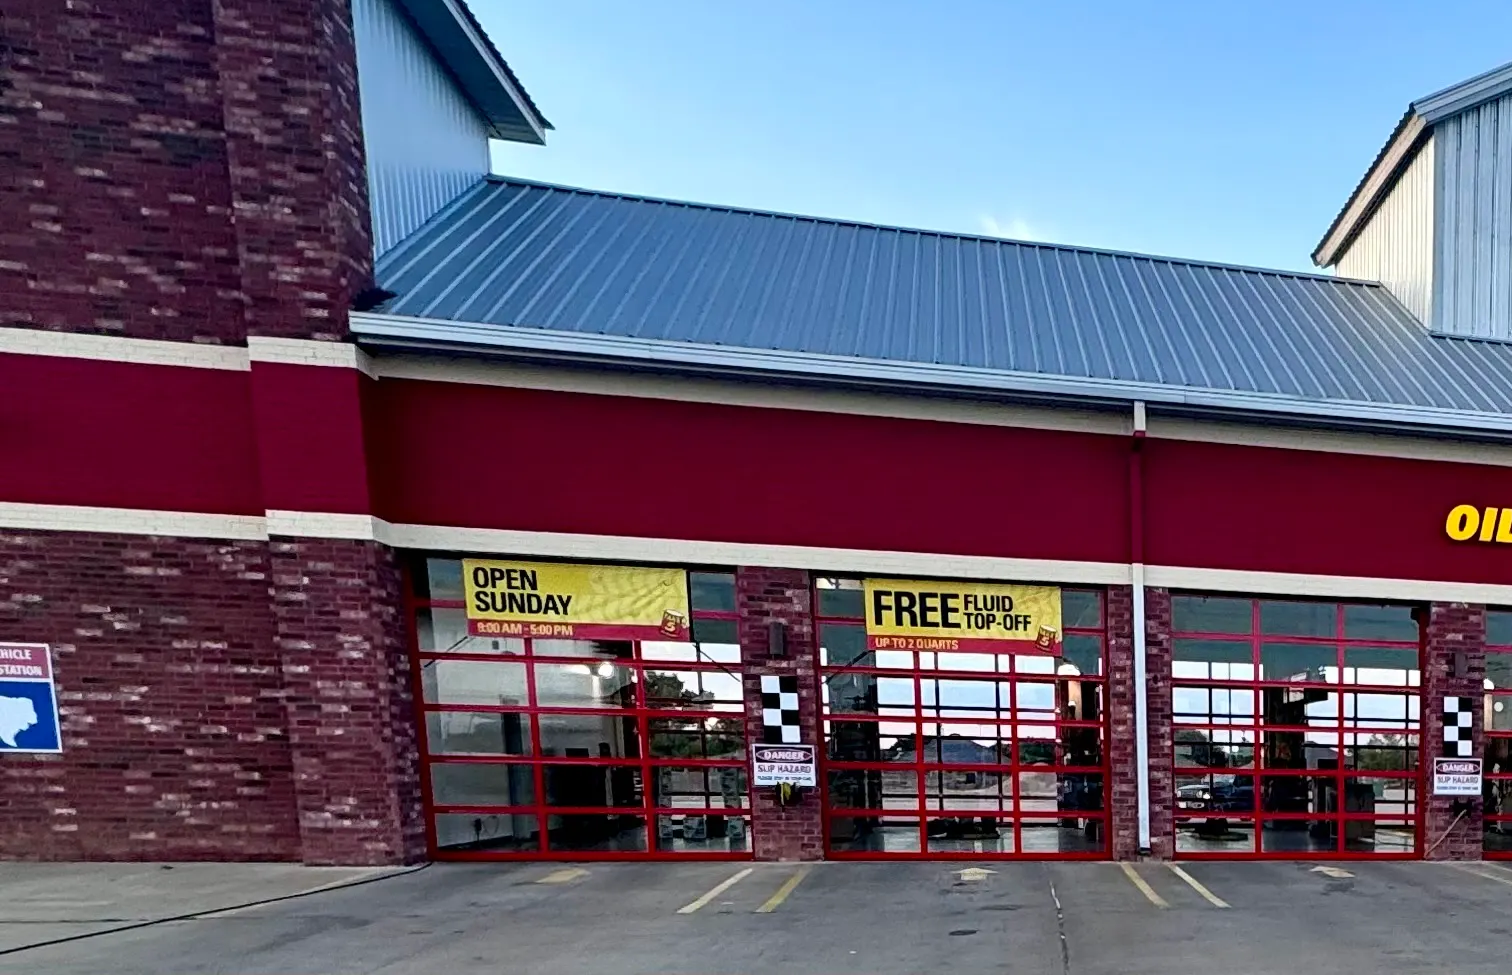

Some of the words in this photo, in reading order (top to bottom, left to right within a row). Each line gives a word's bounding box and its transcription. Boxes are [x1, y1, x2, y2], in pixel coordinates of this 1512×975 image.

[473, 567, 537, 591] OPEN
[475, 590, 572, 615] SUNDAY
[873, 590, 961, 629] FREE
[963, 594, 1013, 612] FLUID
[502, 622, 522, 635] AM
[530, 624, 552, 636] 5:00
[553, 625, 573, 636] PM
[963, 612, 1032, 631] TOP-OFF
[875, 637, 890, 648] UP
[891, 638, 906, 648] TO
[908, 638, 915, 649] 2
[916, 639, 959, 650] QUARTS
